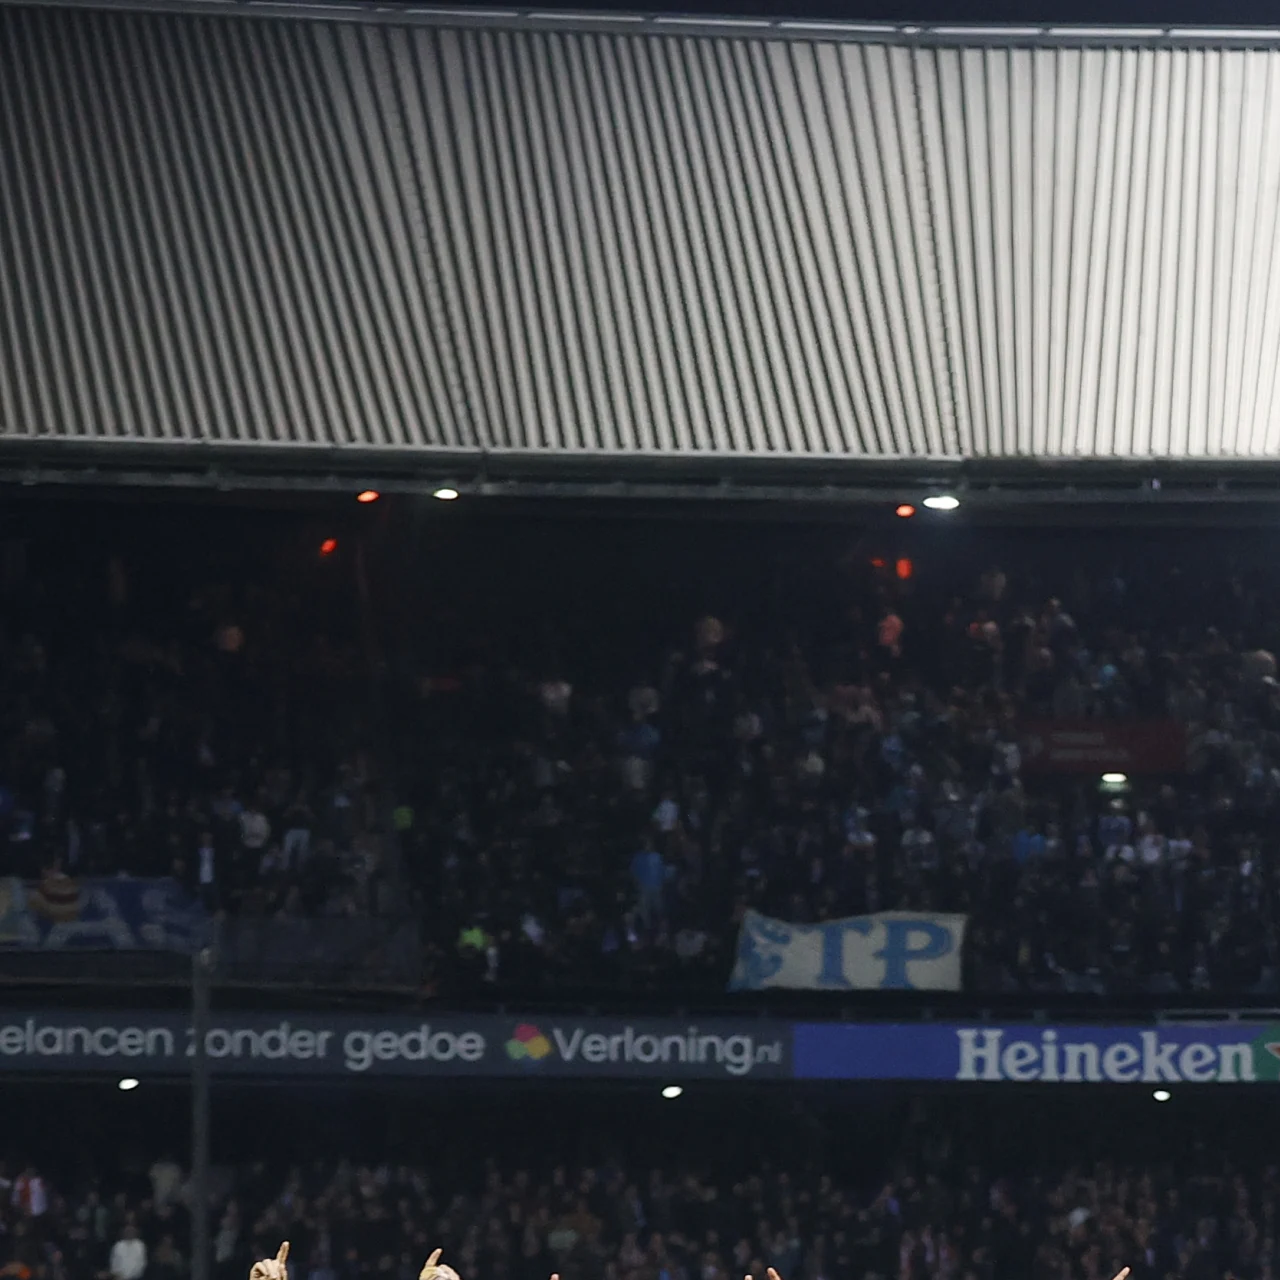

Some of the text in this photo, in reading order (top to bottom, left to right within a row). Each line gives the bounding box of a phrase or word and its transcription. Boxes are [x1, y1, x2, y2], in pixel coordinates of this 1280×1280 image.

[344, 1024, 486, 1072] gedoe
[552, 1026, 784, 1077] Verloning.nl
[956, 1028, 1257, 1082] Heineken
